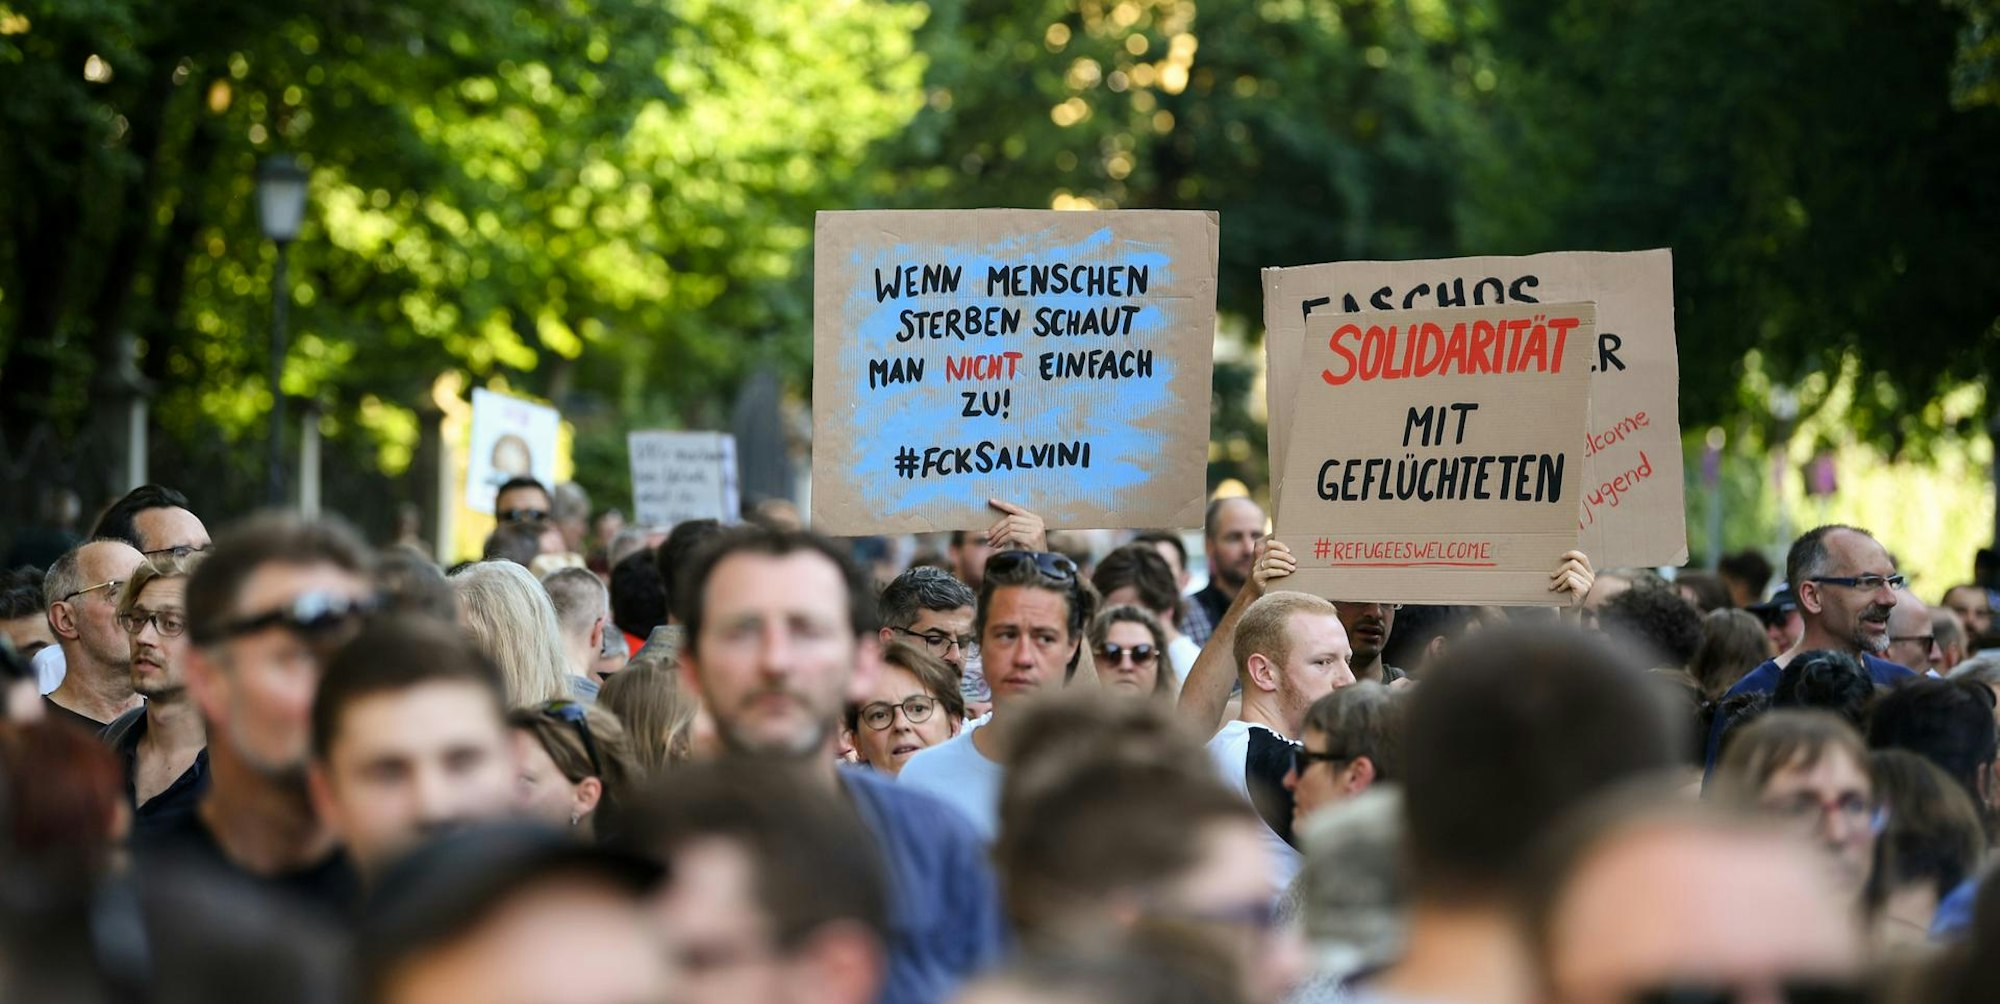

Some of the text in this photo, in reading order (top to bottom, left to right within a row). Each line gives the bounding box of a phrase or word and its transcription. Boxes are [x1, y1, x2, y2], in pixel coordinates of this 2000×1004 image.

[874, 263, 1149, 304] WENN MENSCHEN
[1302, 274, 1540, 316] SCHOS
[895, 305, 1141, 342] STERBEN SCHAUT
[869, 349, 1153, 391] MAN NICHT EINFACH
[1321, 314, 1580, 386] SOLIDARITÄT
[961, 388, 1011, 419] ZU!
[1402, 402, 1479, 447] MIT
[894, 441, 1090, 480] #FCKSALVINI
[1317, 452, 1565, 504] GEFLÜCHTETEN
[1313, 537, 1492, 561] #REFUGEESWELCOME
